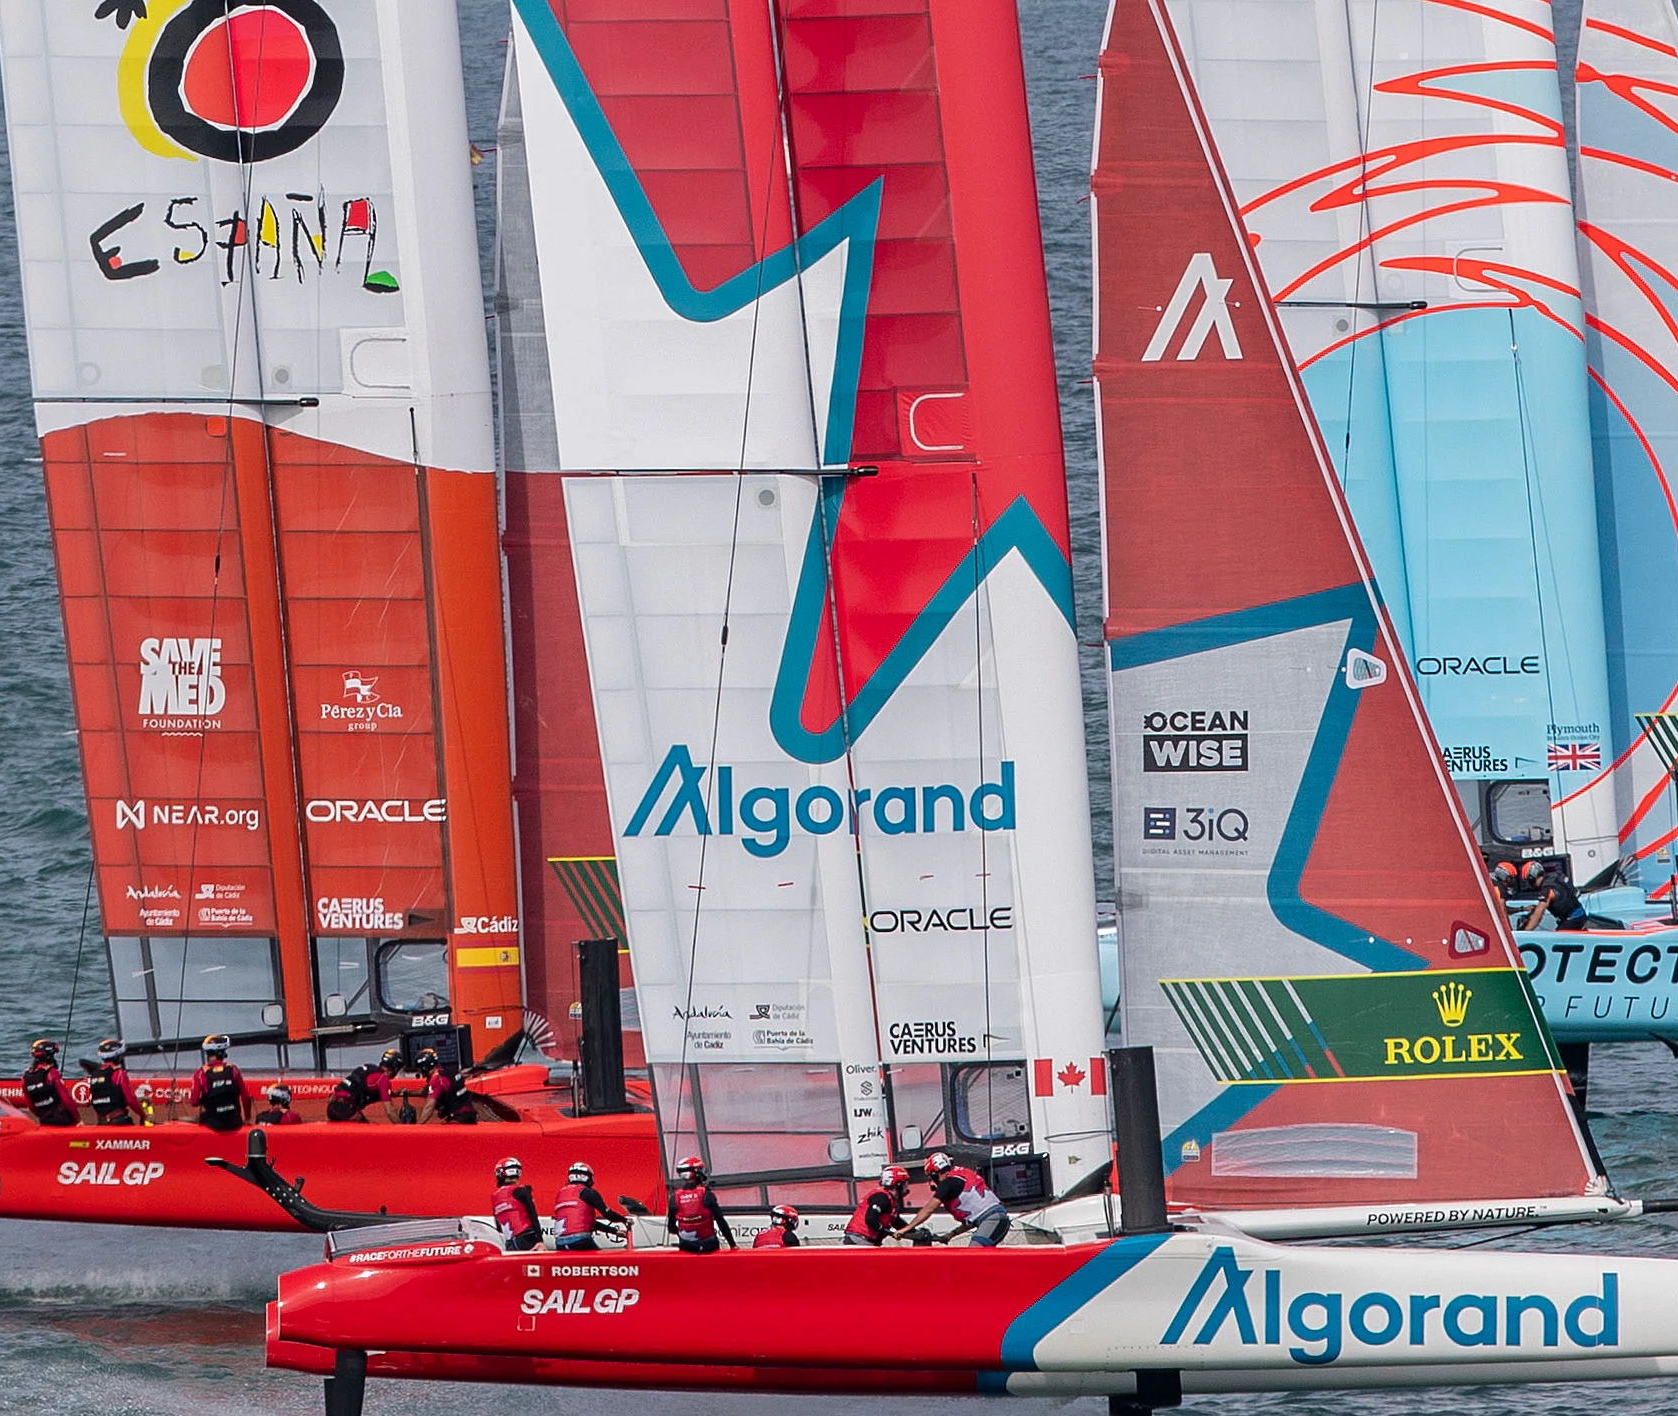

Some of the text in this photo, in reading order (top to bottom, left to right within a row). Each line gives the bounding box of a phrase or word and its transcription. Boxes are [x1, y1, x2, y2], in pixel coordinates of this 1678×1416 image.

[89, 184, 401, 293] ESPAÑA
[139, 637, 222, 676] SAVE
[1416, 656, 1541, 675] ORACLE
[169, 661, 195, 675] THE
[138, 674, 226, 715] MED
[365, 706, 376, 722] y
[1143, 710, 1249, 732] OCEAN
[142, 718, 221, 729] FOUNDATION
[348, 722, 378, 732] group
[1149, 739, 1243, 767] WISE
[1443, 745, 1491, 760] AERUS
[1446, 758, 1508, 773] ENTURES
[622, 744, 1017, 858] Algorand
[152, 805, 260, 831] NEAR.org
[305, 798, 448, 823] ORACLE
[1182, 807, 1249, 842] 3iQ
[1521, 846, 1554, 859] B&G
[125, 884, 182, 900] Andalucía
[317, 897, 384, 914] CAERUS
[318, 912, 404, 930] VENTURES
[476, 915, 519, 932] Cádiz
[869, 906, 1014, 933] ORACLE
[411, 1014, 449, 1027] B&G
[672, 1004, 733, 1020] Andalucía
[889, 1021, 957, 1039] CAERUS
[889, 1037, 977, 1055] VENTURES
[1384, 1032, 1523, 1065] ROLEX
[857, 1126, 885, 1144] zhik
[95, 1139, 151, 1151] XAMMAR
[991, 1142, 1030, 1158] B&G
[1366, 1211, 1446, 1226] POWERED
[1448, 1209, 1470, 1222] BY
[349, 1244, 461, 1264] #RACEFORTHEFUTURE
[551, 1265, 639, 1277] ROBERTSON
[1159, 1246, 1619, 1365] Algorand
